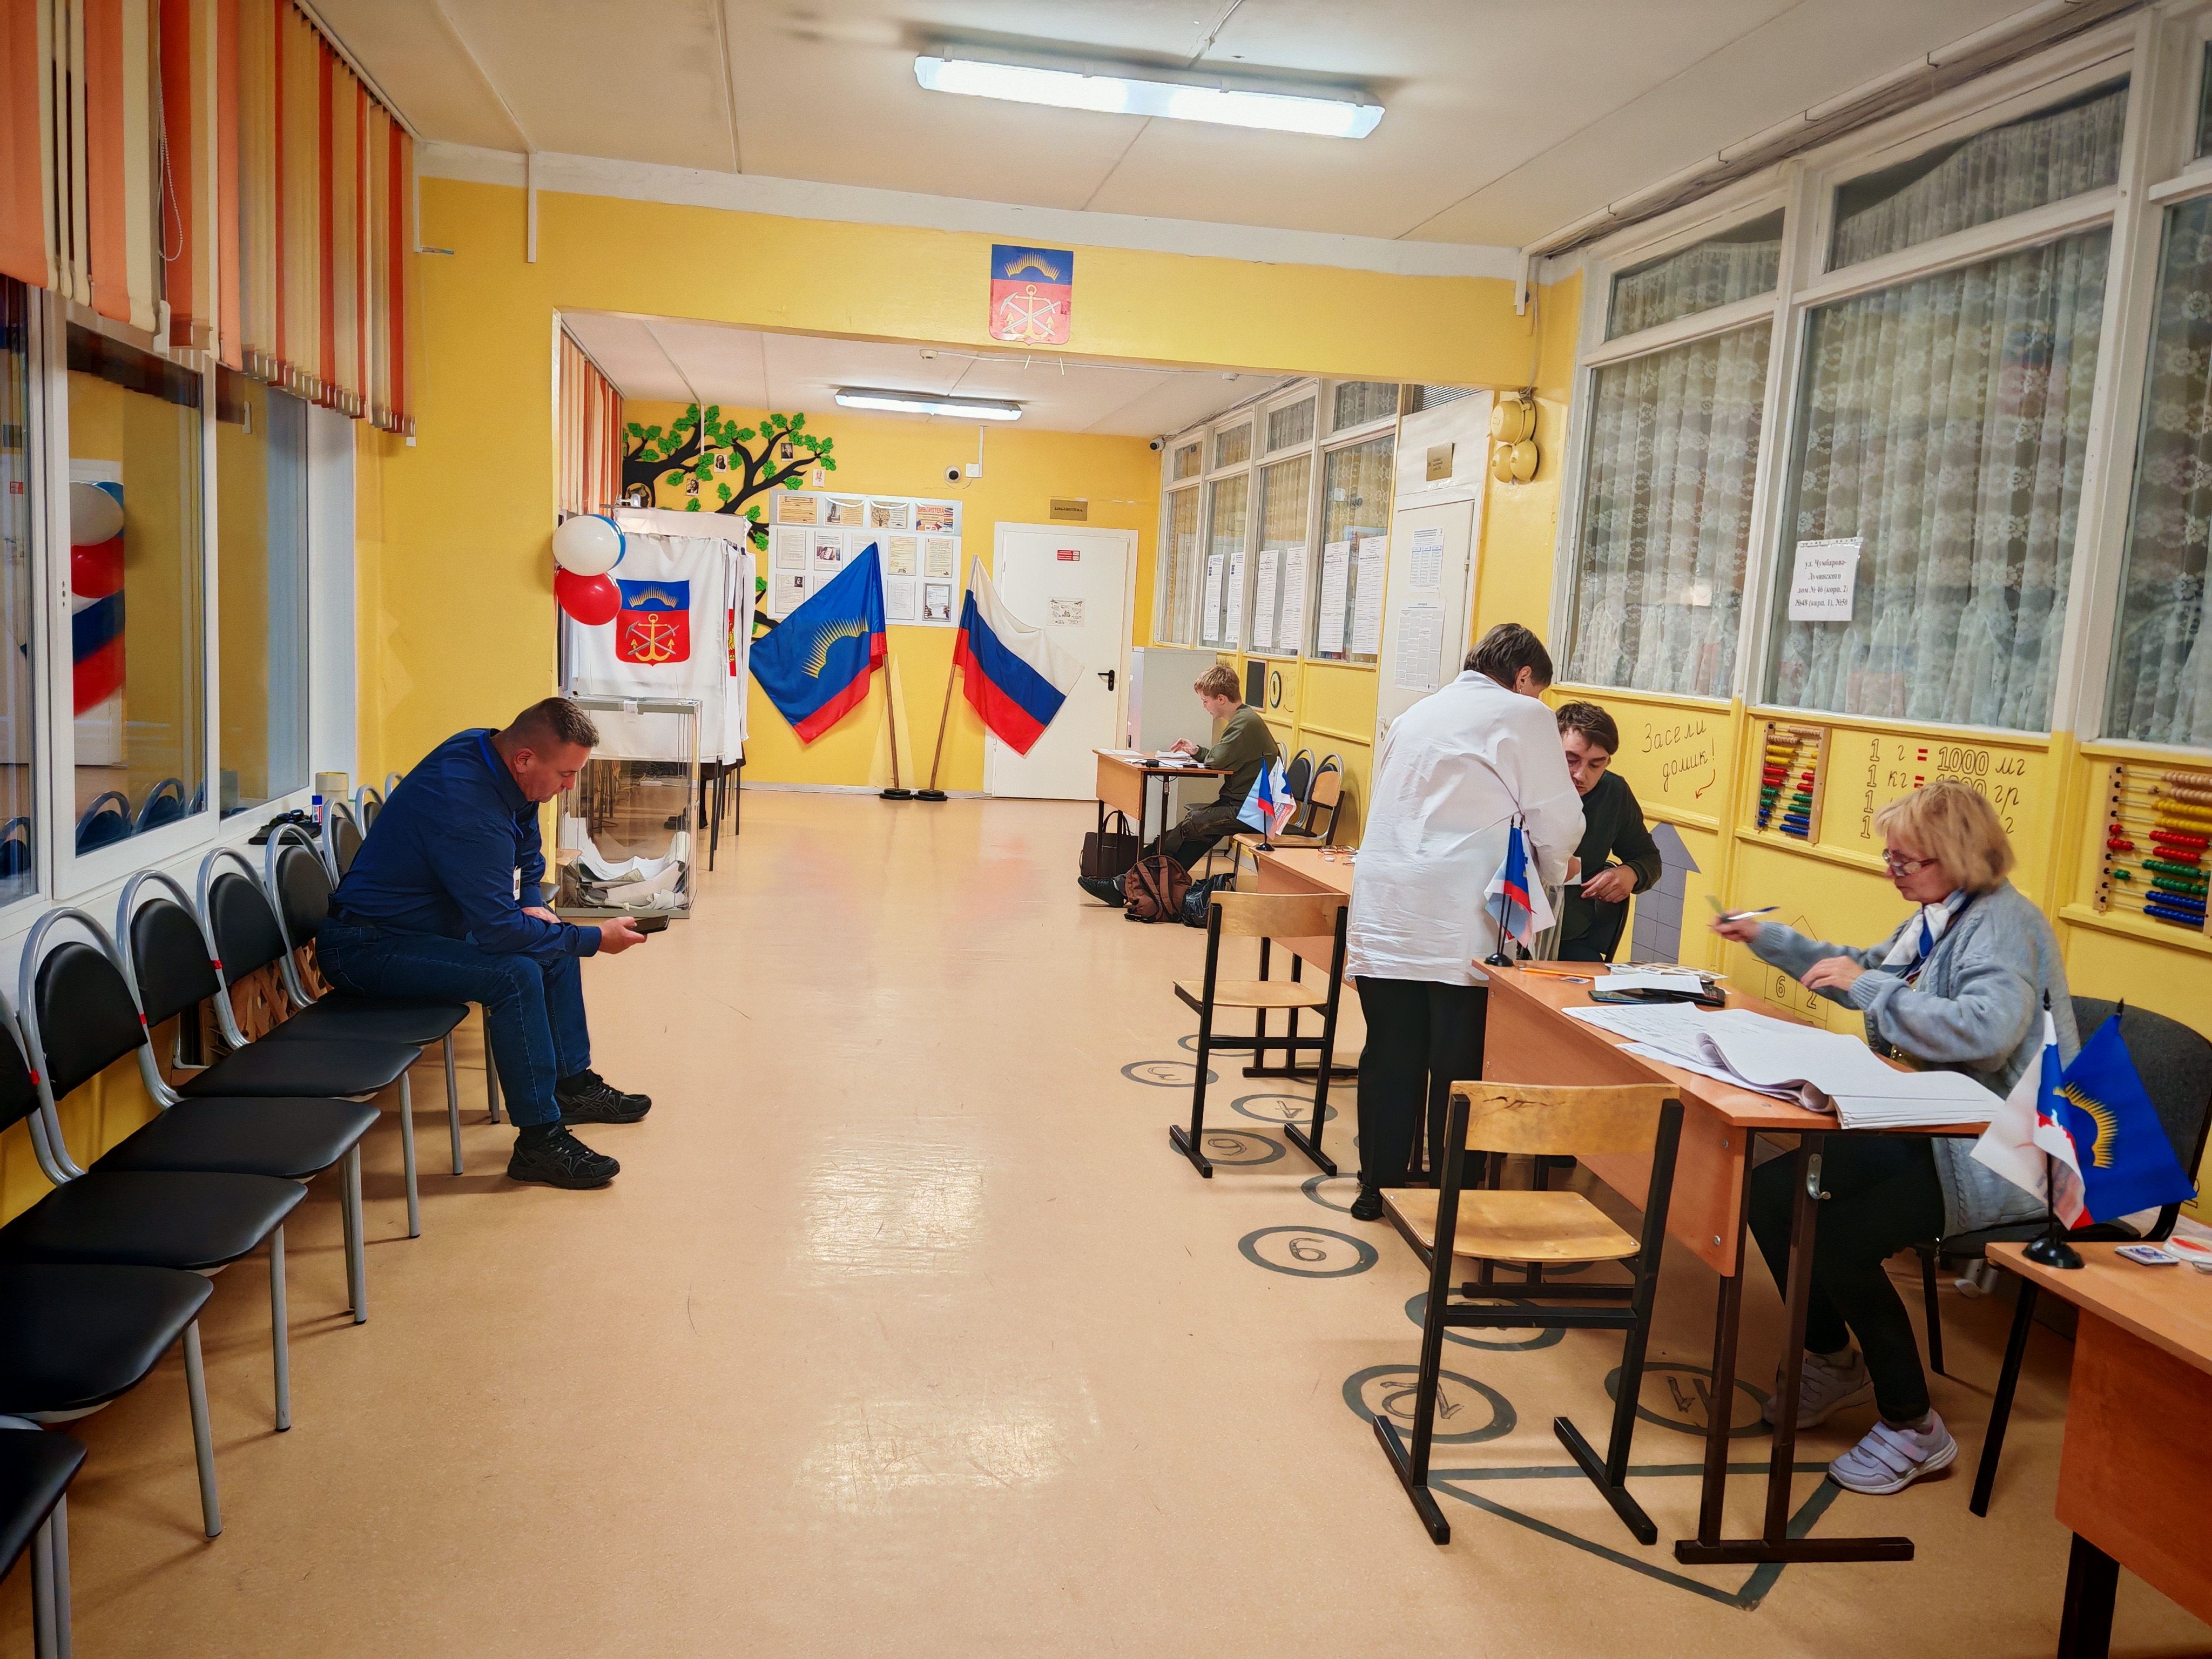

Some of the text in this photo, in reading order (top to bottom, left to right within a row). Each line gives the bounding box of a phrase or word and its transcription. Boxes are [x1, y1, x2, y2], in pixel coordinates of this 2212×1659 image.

[1642, 719, 1707, 753] Засели
[1870, 738, 1880, 761] 1
[1937, 746, 1990, 776] 1000
[1995, 757, 2025, 776] мг
[1864, 790, 1873, 813] 1
[1867, 764, 1877, 787] 1
[1887, 771, 1908, 788] кг
[1994, 785, 2020, 815] гр
[1860, 815, 1871, 839] 1
[1776, 975, 1786, 998] 6
